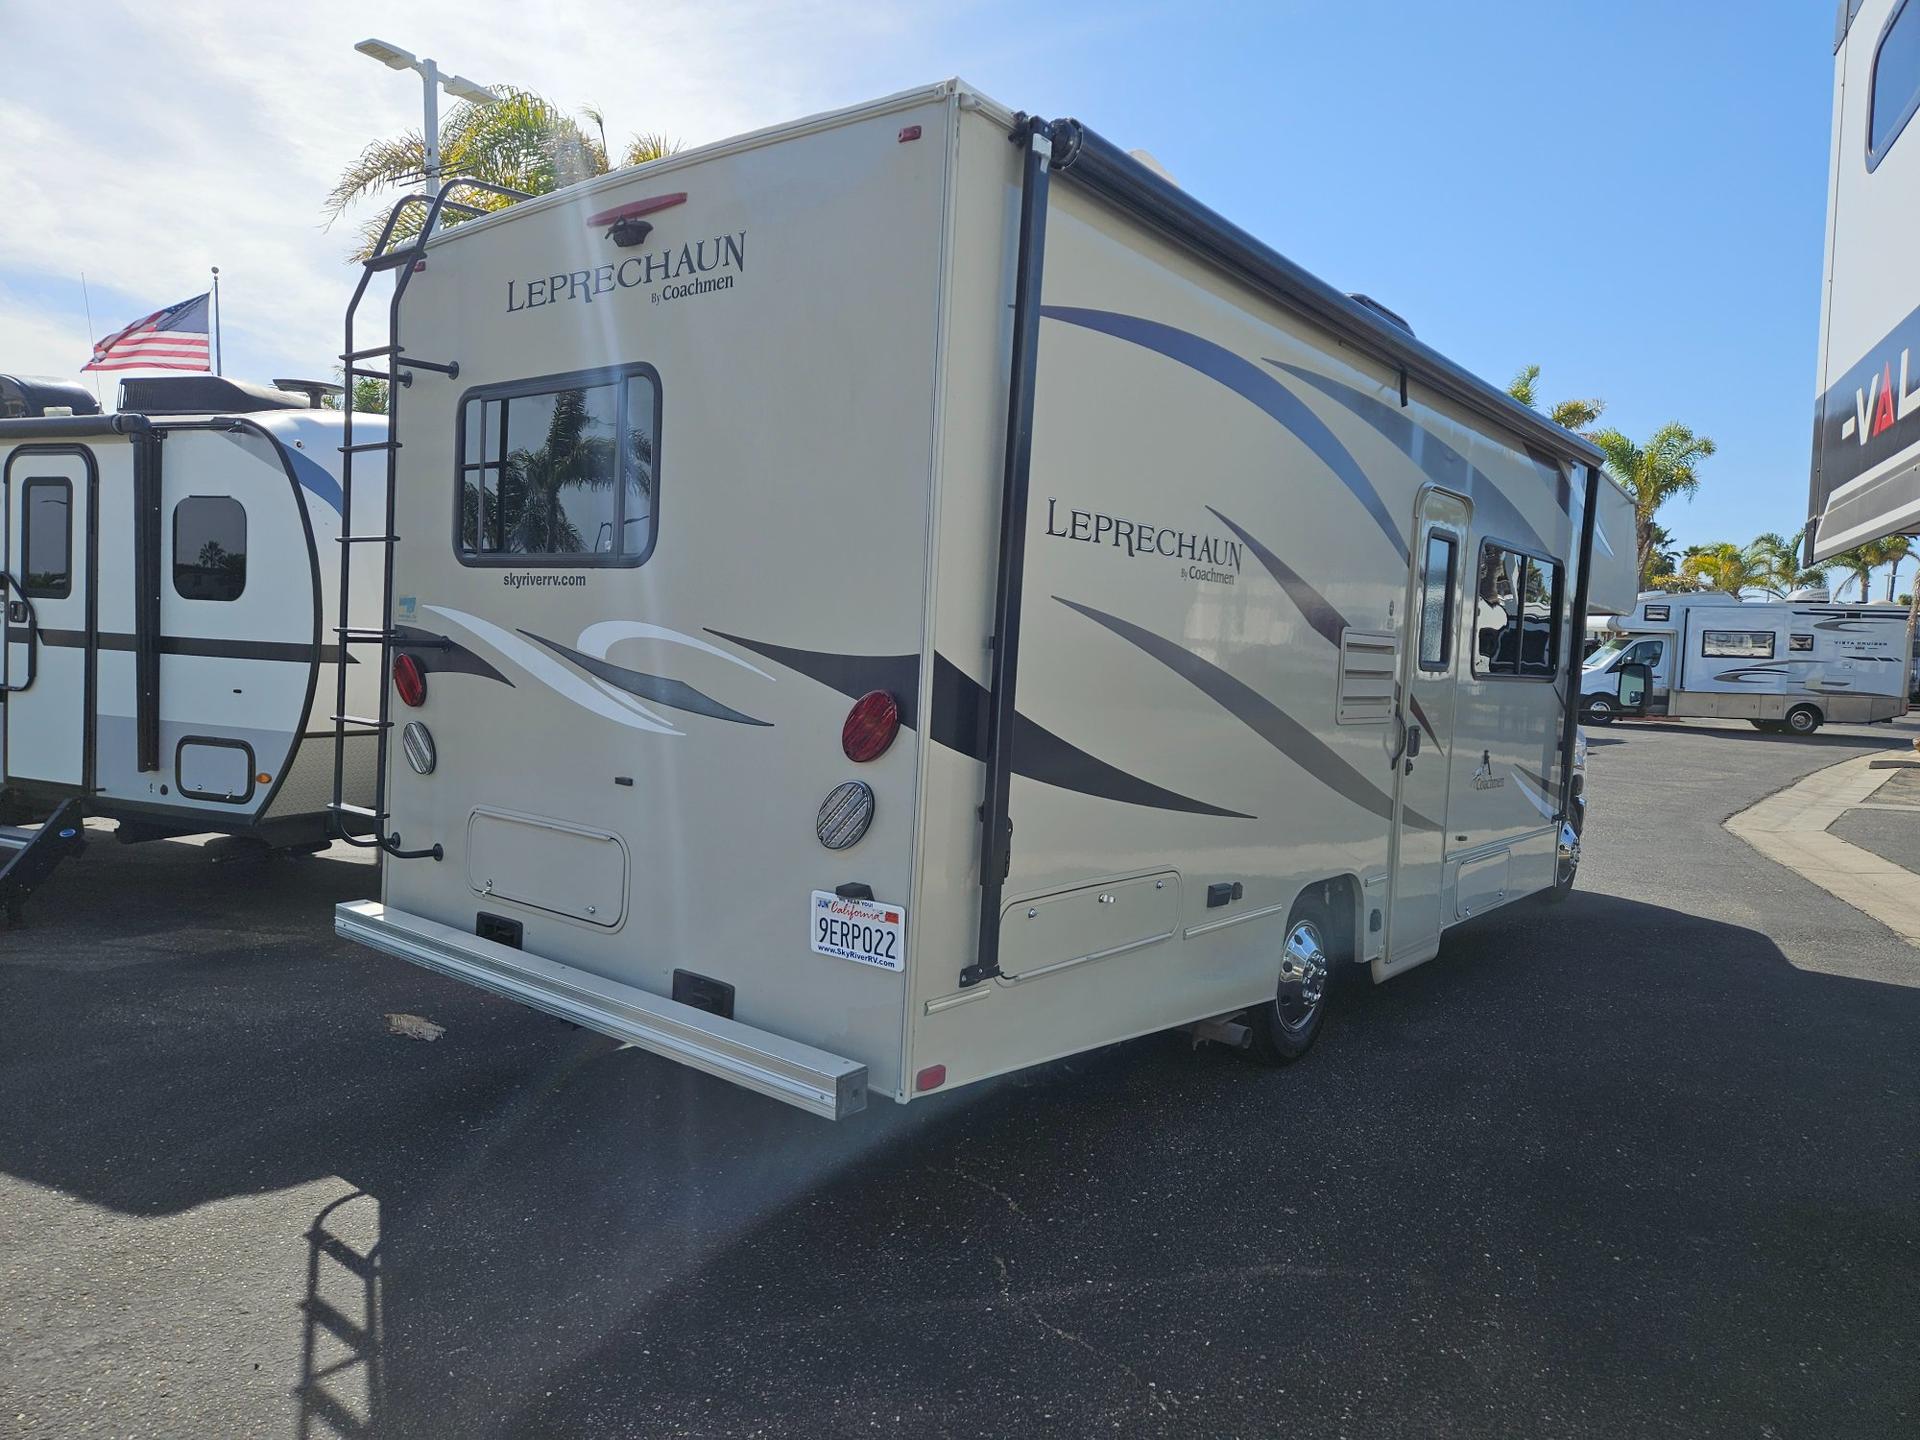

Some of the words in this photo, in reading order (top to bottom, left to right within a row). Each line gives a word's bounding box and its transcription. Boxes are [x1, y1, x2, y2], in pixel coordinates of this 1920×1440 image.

[506, 230, 746, 312] LEPRECHAUN
[651, 292, 662, 305] By
[662, 275, 734, 301] Coachmen
[1045, 497, 1243, 574] LEPRECHAUN
[503, 572, 586, 589] skyriverrv.com
[1189, 565, 1235, 585] Coachmen
[830, 900, 883, 921] California
[819, 917, 896, 959] 9ERP022
[817, 944, 895, 968] www.SkyRiverRV.com
